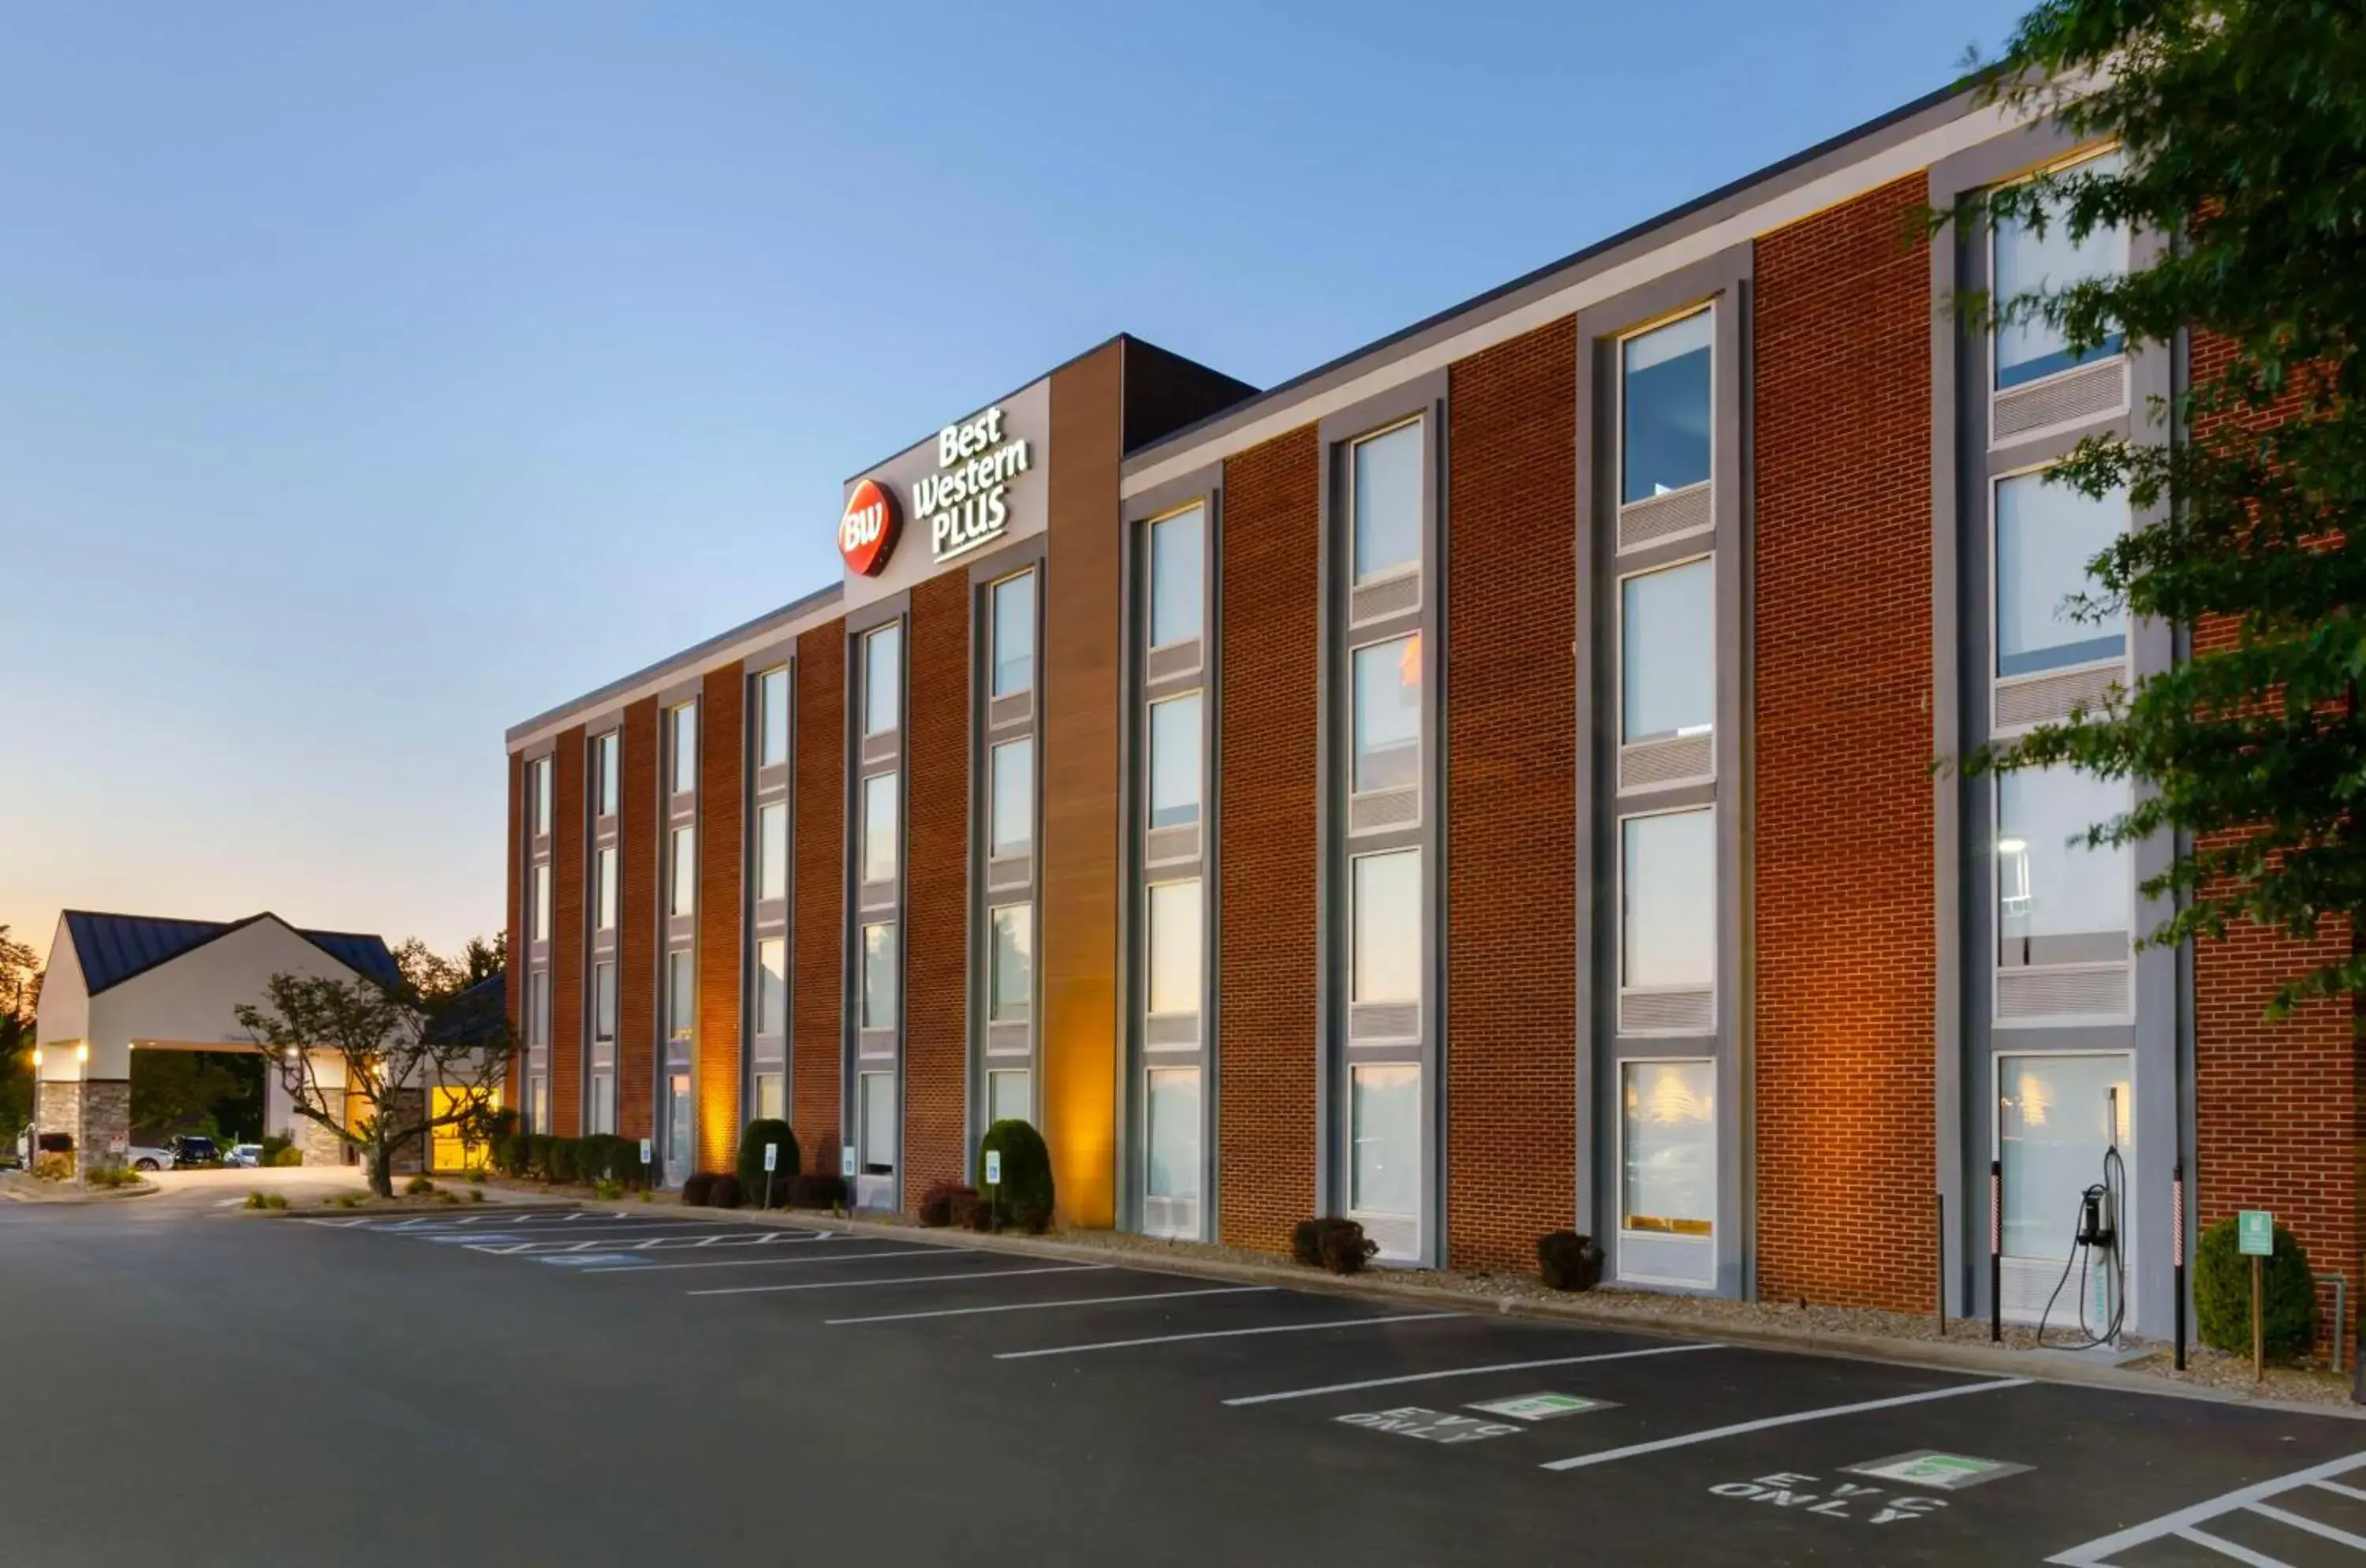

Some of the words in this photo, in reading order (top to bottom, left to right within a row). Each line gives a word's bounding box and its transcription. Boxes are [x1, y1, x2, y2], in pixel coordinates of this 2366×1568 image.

[939, 407, 1001, 468] Best
[912, 439, 1027, 520] Western
[845, 503, 883, 552] BW
[932, 485, 1006, 554] PLUS
[1336, 1413, 1484, 1444] ONLY
[1707, 1483, 1922, 1524] ONLY
[1752, 1473, 1950, 1510] EVC
